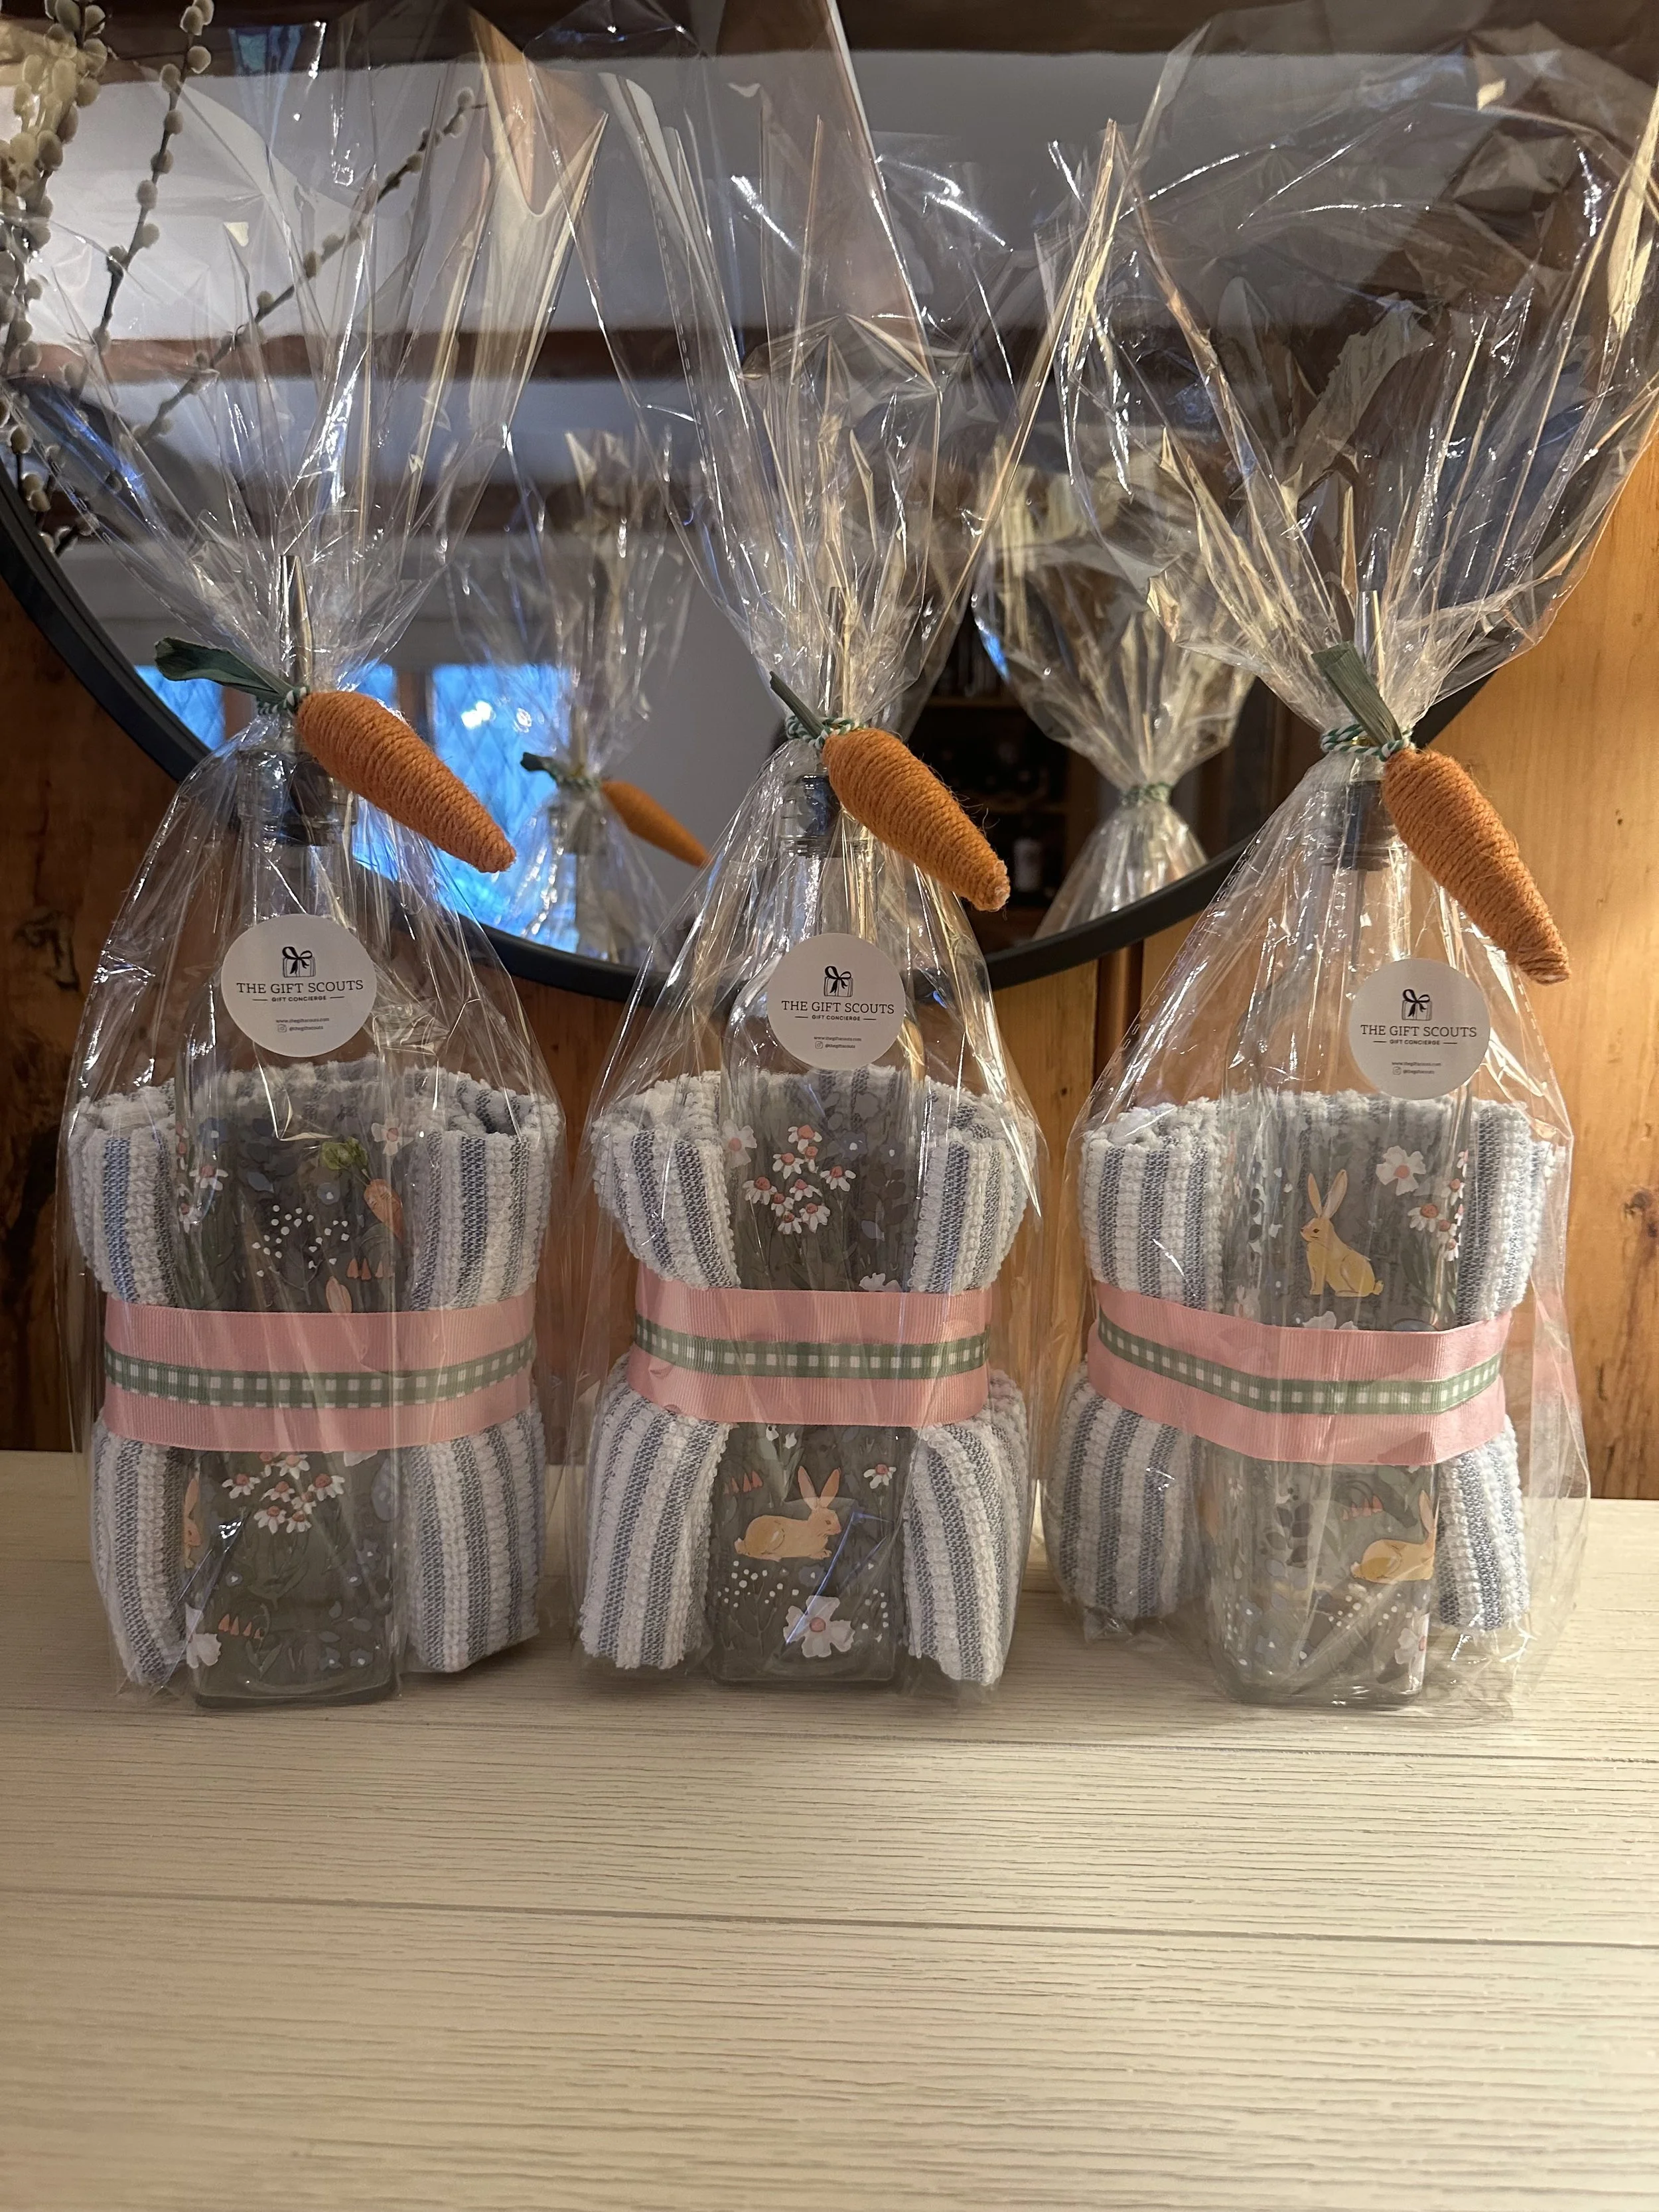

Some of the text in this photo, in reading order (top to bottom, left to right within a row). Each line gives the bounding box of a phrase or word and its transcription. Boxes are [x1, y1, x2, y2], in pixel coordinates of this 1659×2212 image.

[236, 980, 364, 994] THE GIFT SCOUTS
[781, 1000, 895, 1014] THE GIFT SCOUTS
[1360, 1025, 1477, 1037] THE GIFT SCOUTS
